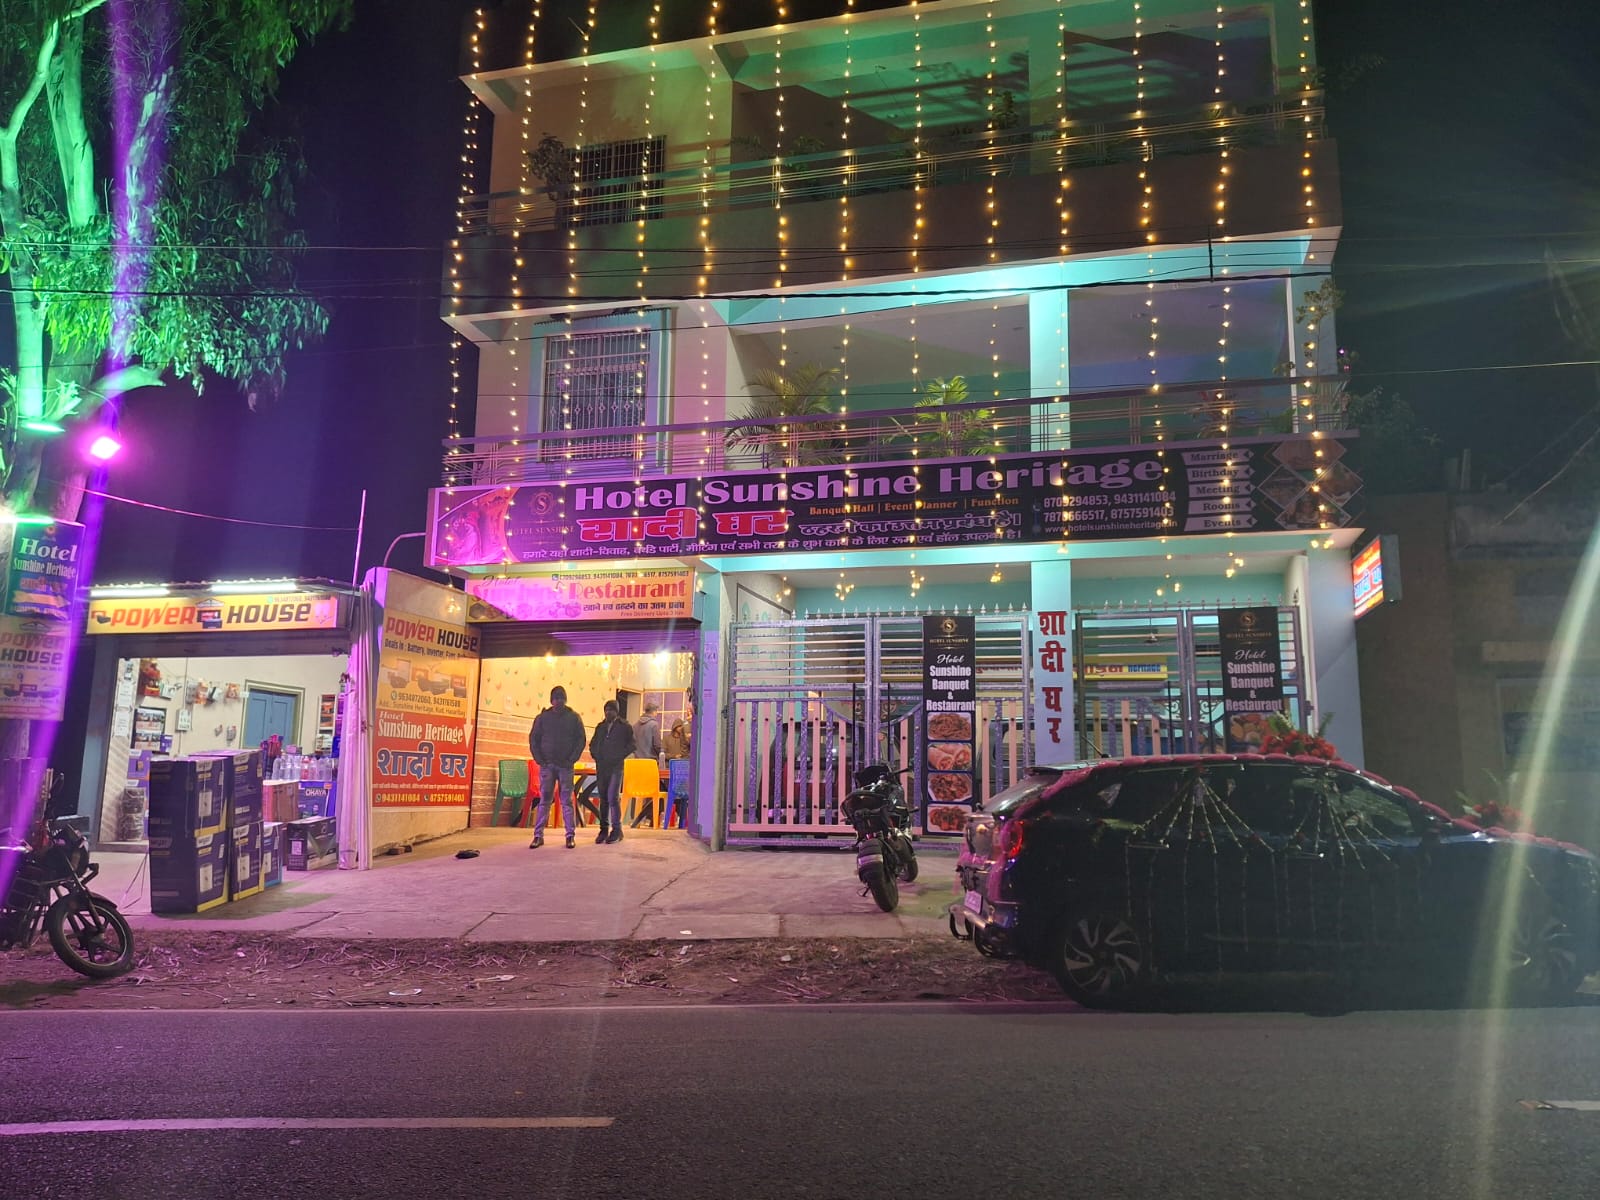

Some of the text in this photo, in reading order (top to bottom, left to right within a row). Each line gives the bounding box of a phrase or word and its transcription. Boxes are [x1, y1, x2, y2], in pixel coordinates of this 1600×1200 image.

[1191, 468, 1238, 478] Birthday
[575, 458, 1164, 511] Hotel Sunshine Heritage
[1196, 485, 1240, 494] Meeting
[1114, 491, 1176, 504] 9431141084
[853, 504, 874, 513] Hall
[885, 502, 914, 511] Event
[971, 497, 1019, 507] Function
[1203, 502, 1240, 511] Rooms
[1111, 507, 1174, 519] 8757591403
[576, 507, 702, 543] शादी
[1204, 518, 1240, 528] Events
[19, 537, 78, 562] Hotel
[14, 556, 77, 579] Sunshine Heritage
[568, 579, 687, 601] Restaurant
[937, 654, 964, 664] Hotel
[1235, 649, 1267, 660] Hotel
[929, 665, 972, 677] Sunshine
[1227, 661, 1276, 674] Sunshine
[932, 679, 970, 691] Banquet
[1231, 677, 1274, 689] Banquet
[947, 691, 954, 700] &
[1249, 690, 1257, 698] &
[926, 700, 976, 711] Restaurant
[1225, 699, 1283, 711] Restaurant
[380, 711, 405, 721] Hotel
[378, 719, 464, 744] Sunshine Heritage
[377, 741, 468, 780] शादी घर
[305, 788, 327, 797] OKAYA
